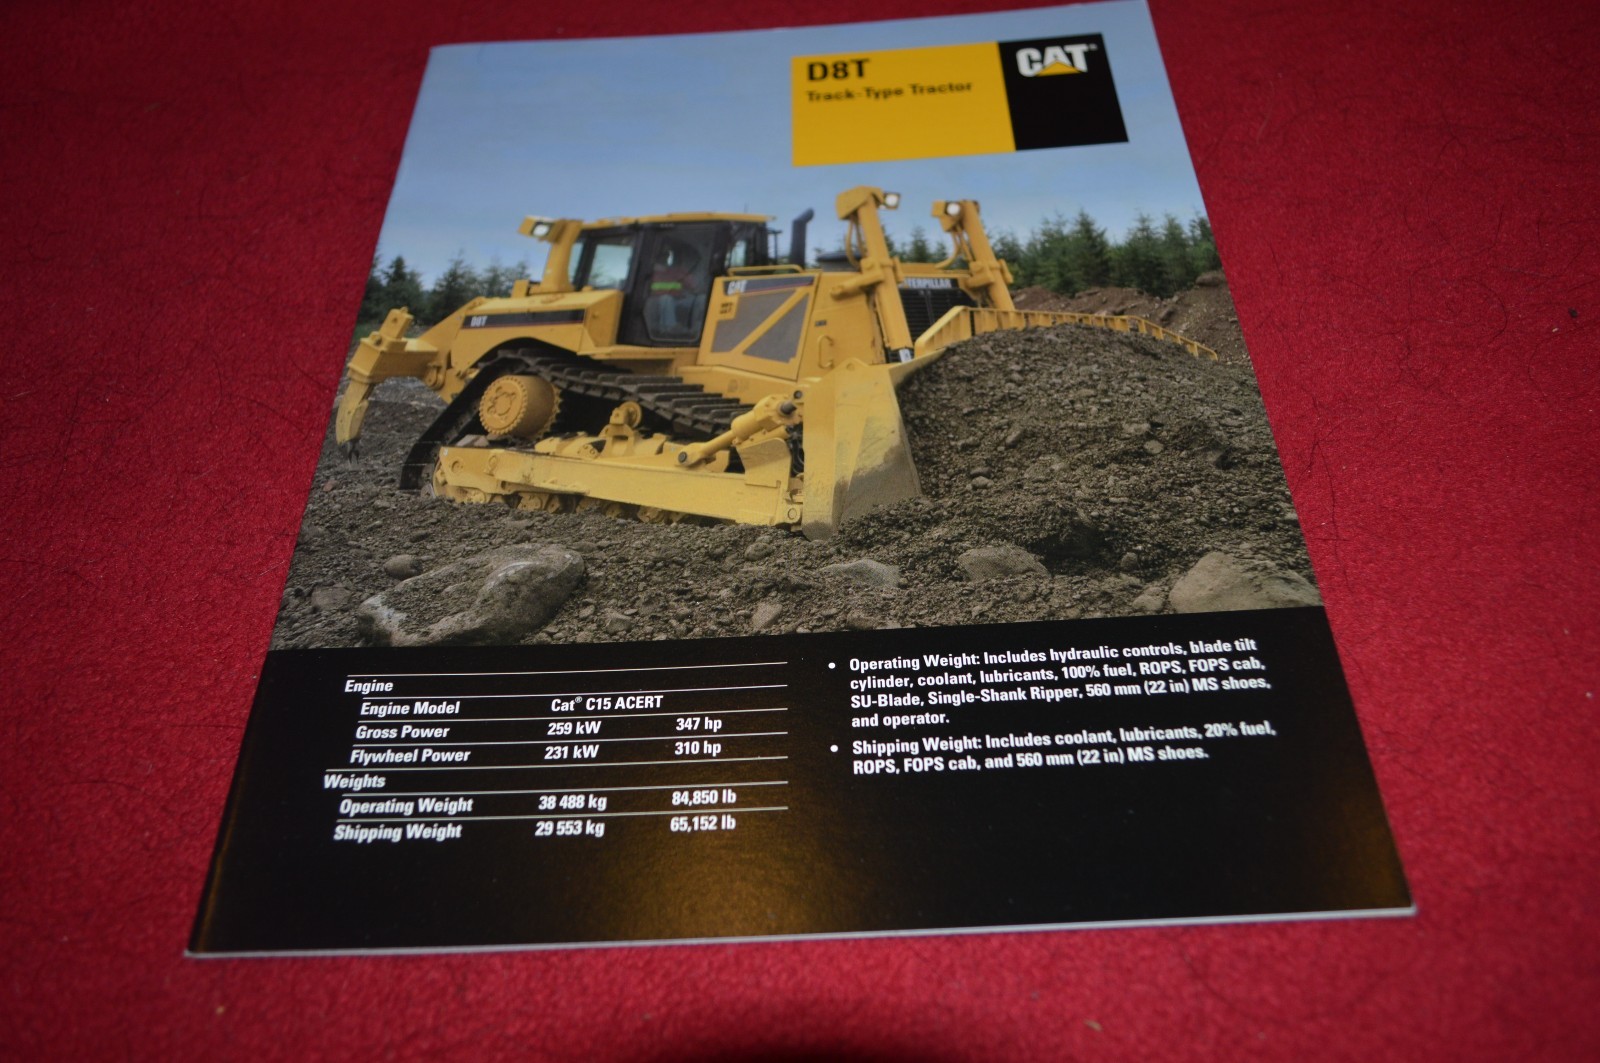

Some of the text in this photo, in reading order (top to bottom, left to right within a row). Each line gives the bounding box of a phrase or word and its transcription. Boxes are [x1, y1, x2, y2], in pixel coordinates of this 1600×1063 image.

[807, 58, 870, 82] D8T
[807, 82, 972, 101] Track-Type Tractor
[850, 638, 1257, 673] Operating Weight: Includes hydraulic controls, blade tilt
[850, 656, 1265, 692] cylinder, coolant, lubricants, 100% fuel, ROPS, FOPS cab,
[345, 679, 393, 694] Engine
[851, 676, 1271, 708] SU-Blade, Single-Shank Ripper, 560 mm (22 in) MS shoes,
[361, 701, 460, 717] Engine Model
[586, 698, 611, 710] C15
[614, 695, 663, 709] ACERT
[547, 721, 601, 735] 259 kW
[676, 717, 722, 732] 347 hp
[852, 713, 949, 729] and operator.
[356, 725, 450, 739] Gross Power
[853, 720, 1276, 757] Shipping Weight: Includes coolant, lubricants, 20% fuel,
[350, 748, 471, 766] Flywheel Power
[544, 745, 599, 759] 231 kW
[675, 740, 721, 757] 310 hp
[853, 745, 1209, 775] ROPS, FOPS cab, and 560 mm (22 in) MS shoes.
[324, 774, 385, 791] Weights
[538, 794, 607, 811] 38 488 kg
[672, 789, 737, 806] 84,850 lb
[340, 797, 473, 817] Operating Weight
[535, 819, 605, 837] 29 553 kg
[670, 814, 736, 833] 65,152 lb
[334, 823, 462, 842] Shipping Weight
